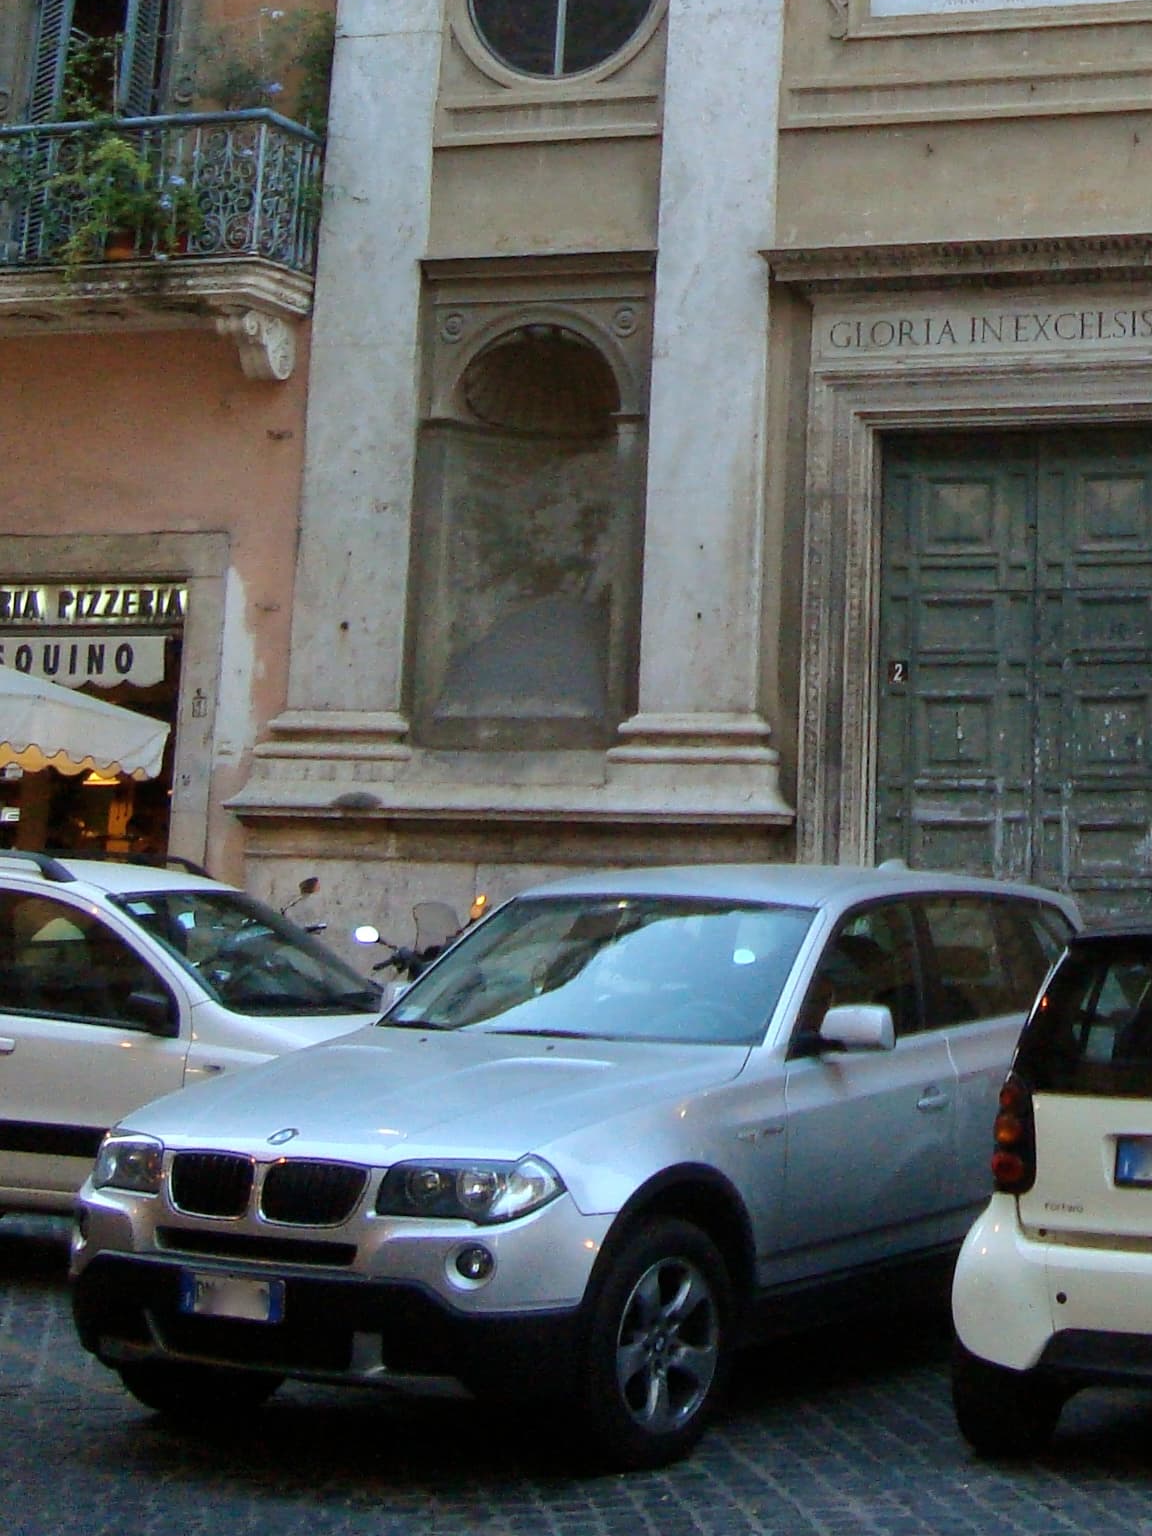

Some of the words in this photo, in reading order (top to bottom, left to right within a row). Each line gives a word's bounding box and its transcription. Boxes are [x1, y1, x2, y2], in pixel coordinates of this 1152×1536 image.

[829, 317, 957, 349] GLORIA
[969, 314, 1004, 343] IN
[58, 589, 183, 619] PIZZERIA
[0, 642, 134, 675] QUINO
[893, 663, 903, 681] 2
